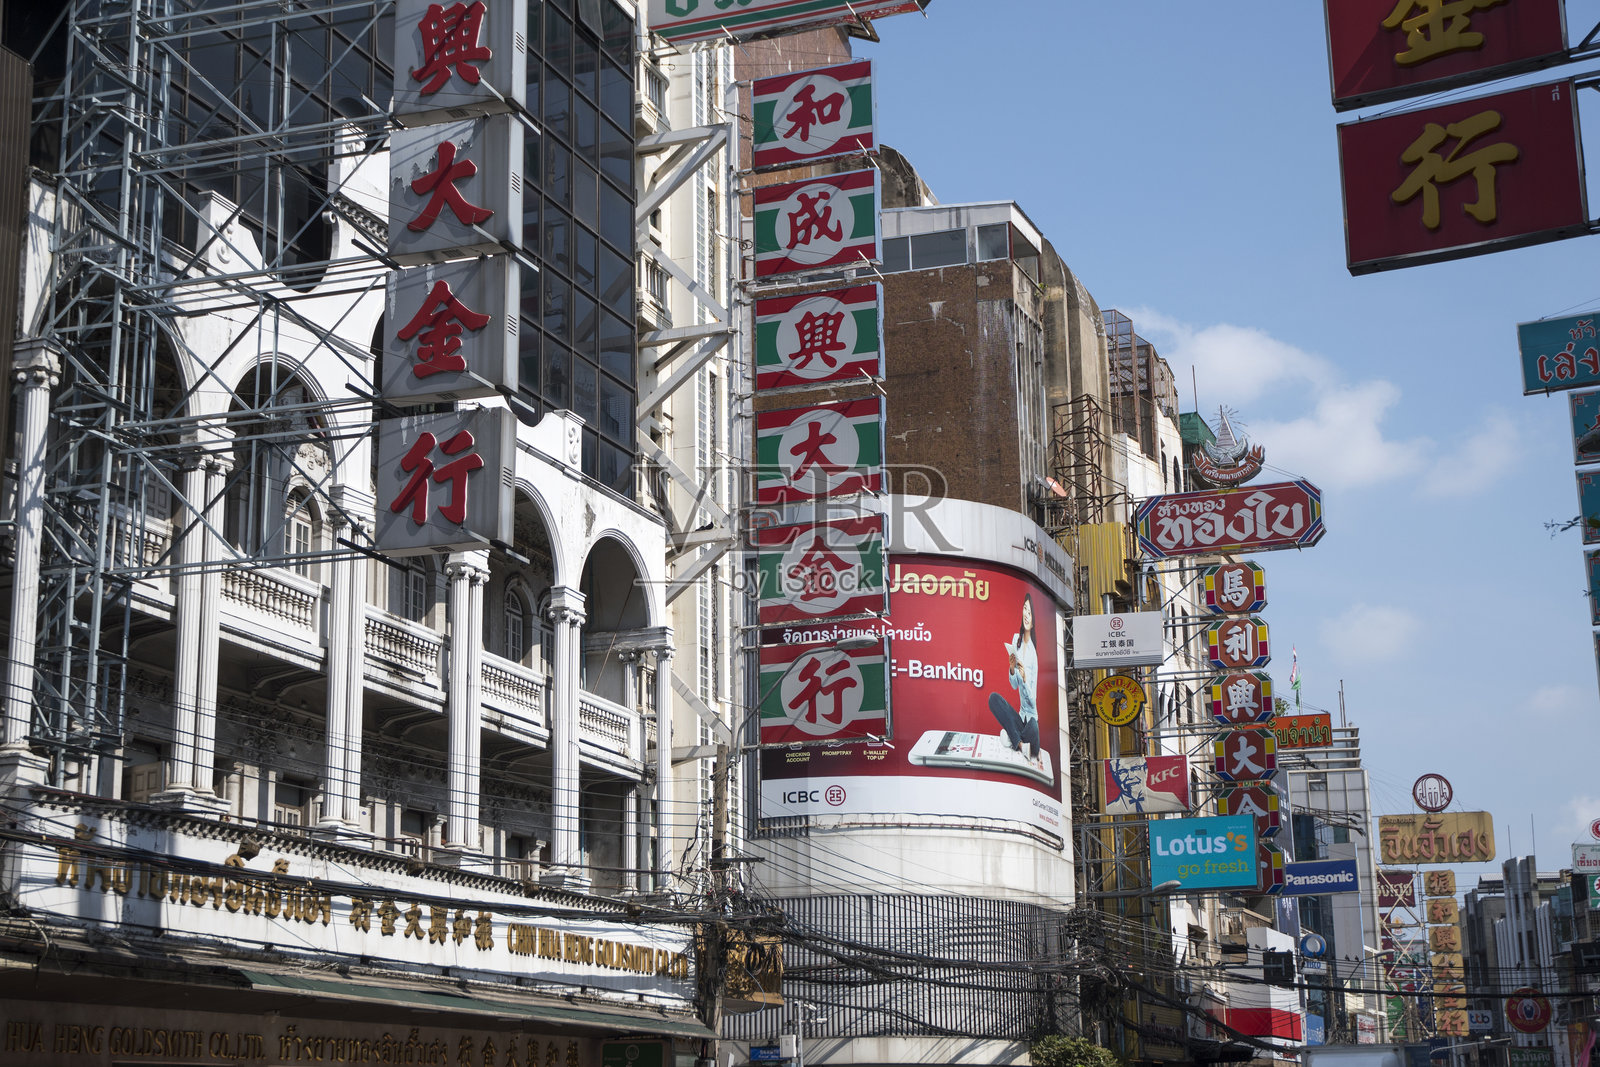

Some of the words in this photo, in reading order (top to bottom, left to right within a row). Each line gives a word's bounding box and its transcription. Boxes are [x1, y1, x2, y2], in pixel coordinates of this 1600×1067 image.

[1157, 499, 1226, 518] ห้างทอง
[1101, 639, 1135, 649] 工银泰国
[1150, 766, 1180, 786] KFC
[783, 790, 820, 804] ICBC
[1156, 832, 1248, 856] Lotus's
[1178, 864, 1200, 879] go
[1203, 859, 1249, 874] fresh
[1285, 871, 1354, 886] Panasonic
[507, 922, 537, 957] CHIN
[538, 928, 562, 961] HUA
[564, 932, 594, 966] HENG
[595, 938, 654, 975] GOLDSMITH
[1470, 1013, 1490, 1024] ttb
[5, 1021, 44, 1053] HUA
[53, 1023, 105, 1055] HENG
[109, 1026, 204, 1058] GOLDSMITH
